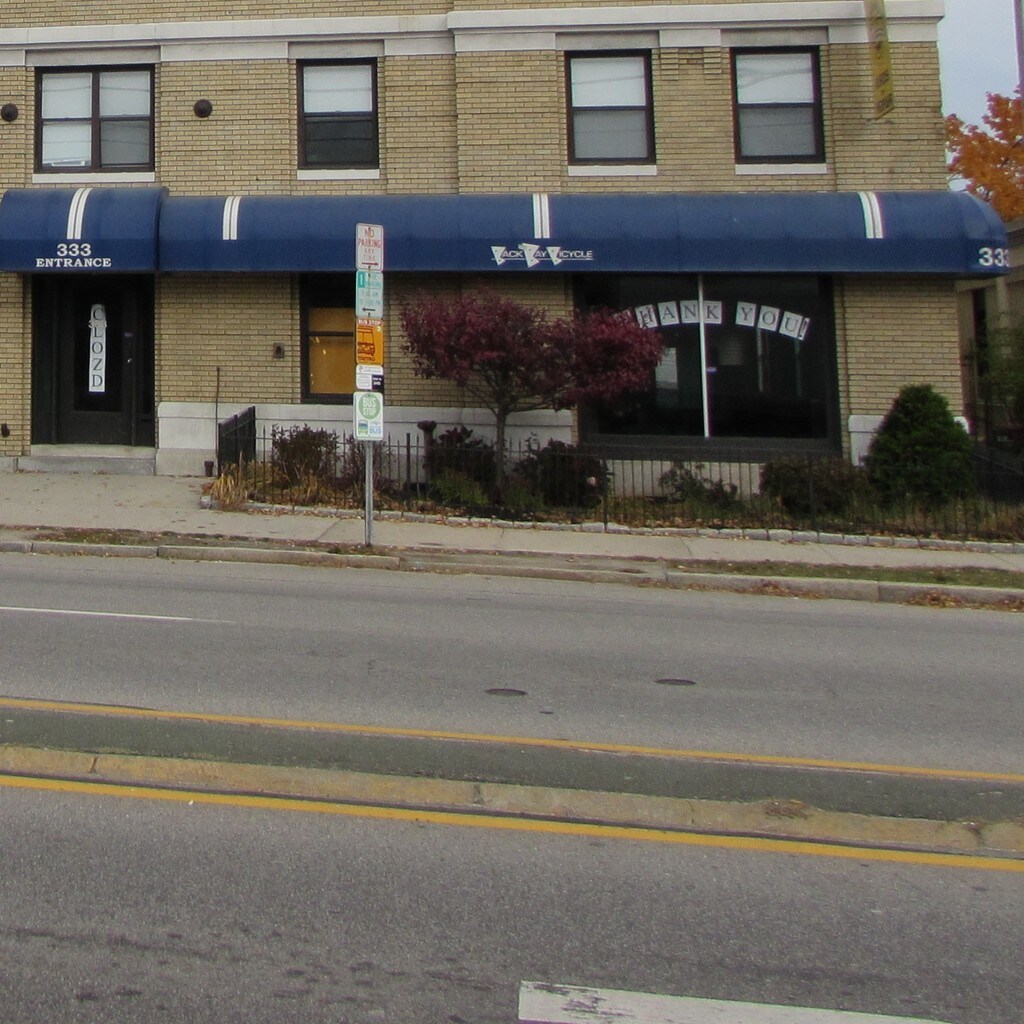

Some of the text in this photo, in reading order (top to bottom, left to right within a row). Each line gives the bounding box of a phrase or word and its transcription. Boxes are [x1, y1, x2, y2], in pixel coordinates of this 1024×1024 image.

[364, 228, 375, 238] NO
[57, 243, 92, 256] 333
[36, 258, 112, 267] ENTRANCE
[739, 306, 809, 337] YOU!
[91, 307, 104, 389] CLOZD
[363, 396, 376, 407] BUS
[363, 407, 376, 416] STOP
